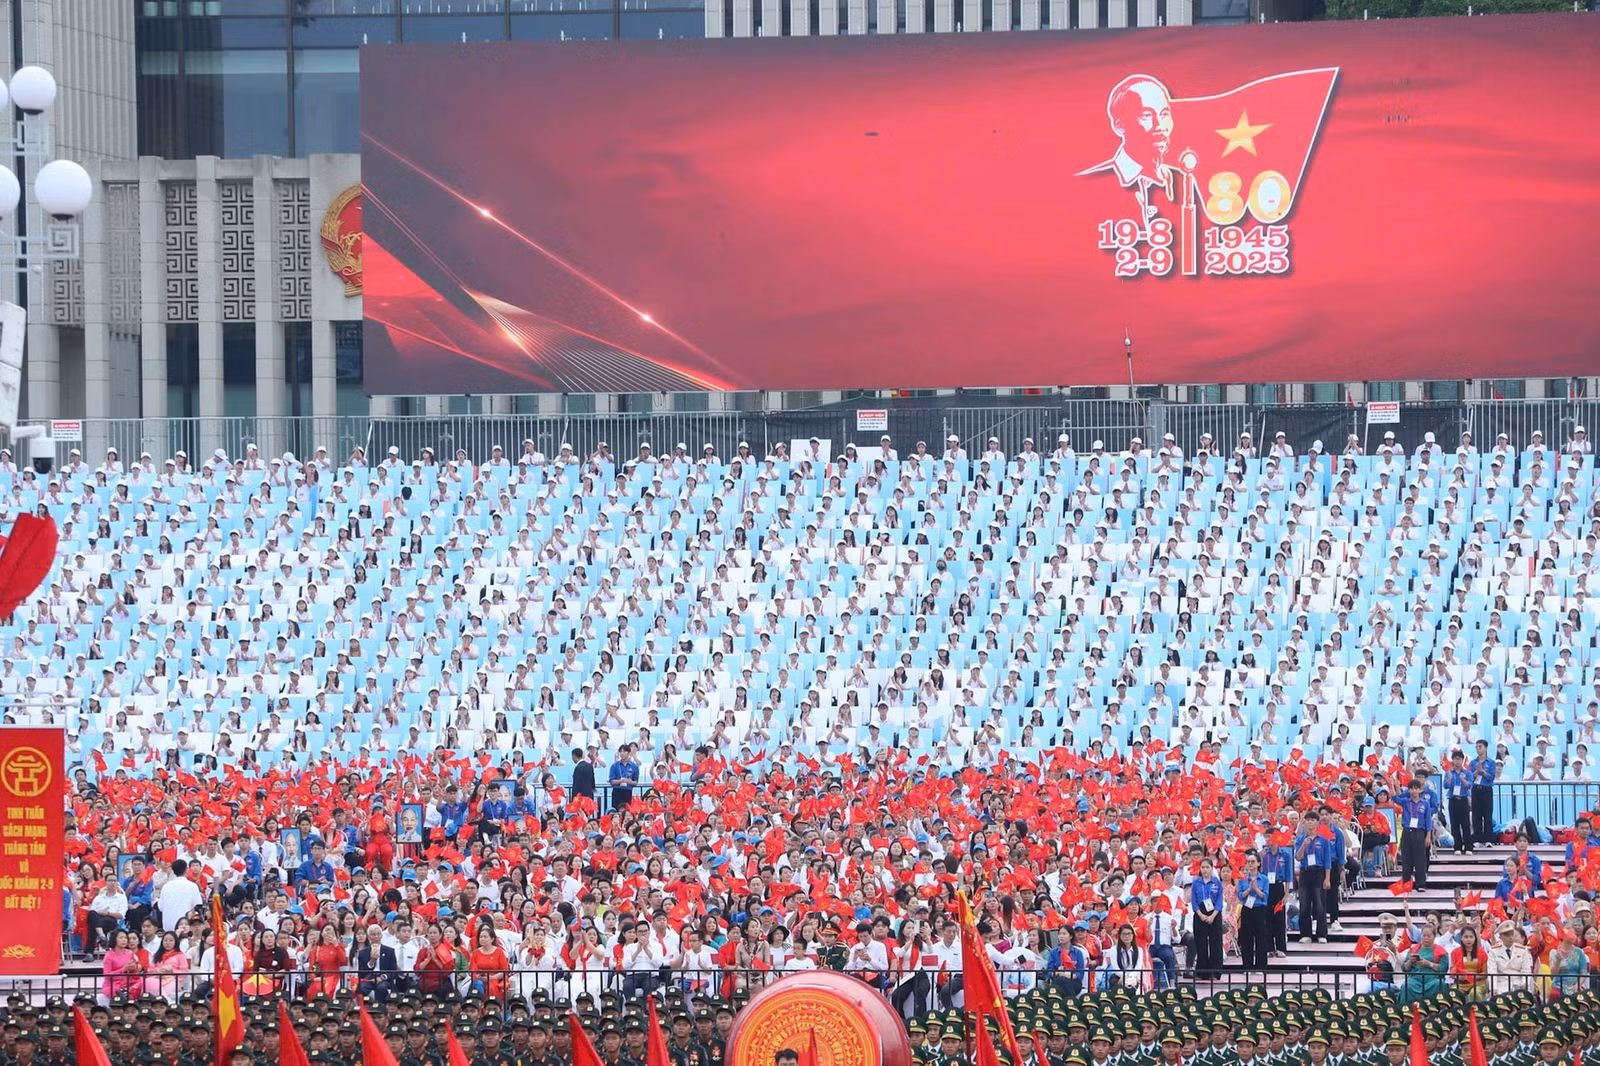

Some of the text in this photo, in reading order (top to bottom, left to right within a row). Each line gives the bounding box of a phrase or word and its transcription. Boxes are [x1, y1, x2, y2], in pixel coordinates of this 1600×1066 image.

[1206, 170, 1291, 225] 80
[1098, 218, 1173, 248] 19-8
[1204, 225, 1289, 251] 1945
[1115, 247, 1173, 276] 2-9
[1204, 249, 1289, 274] 2025
